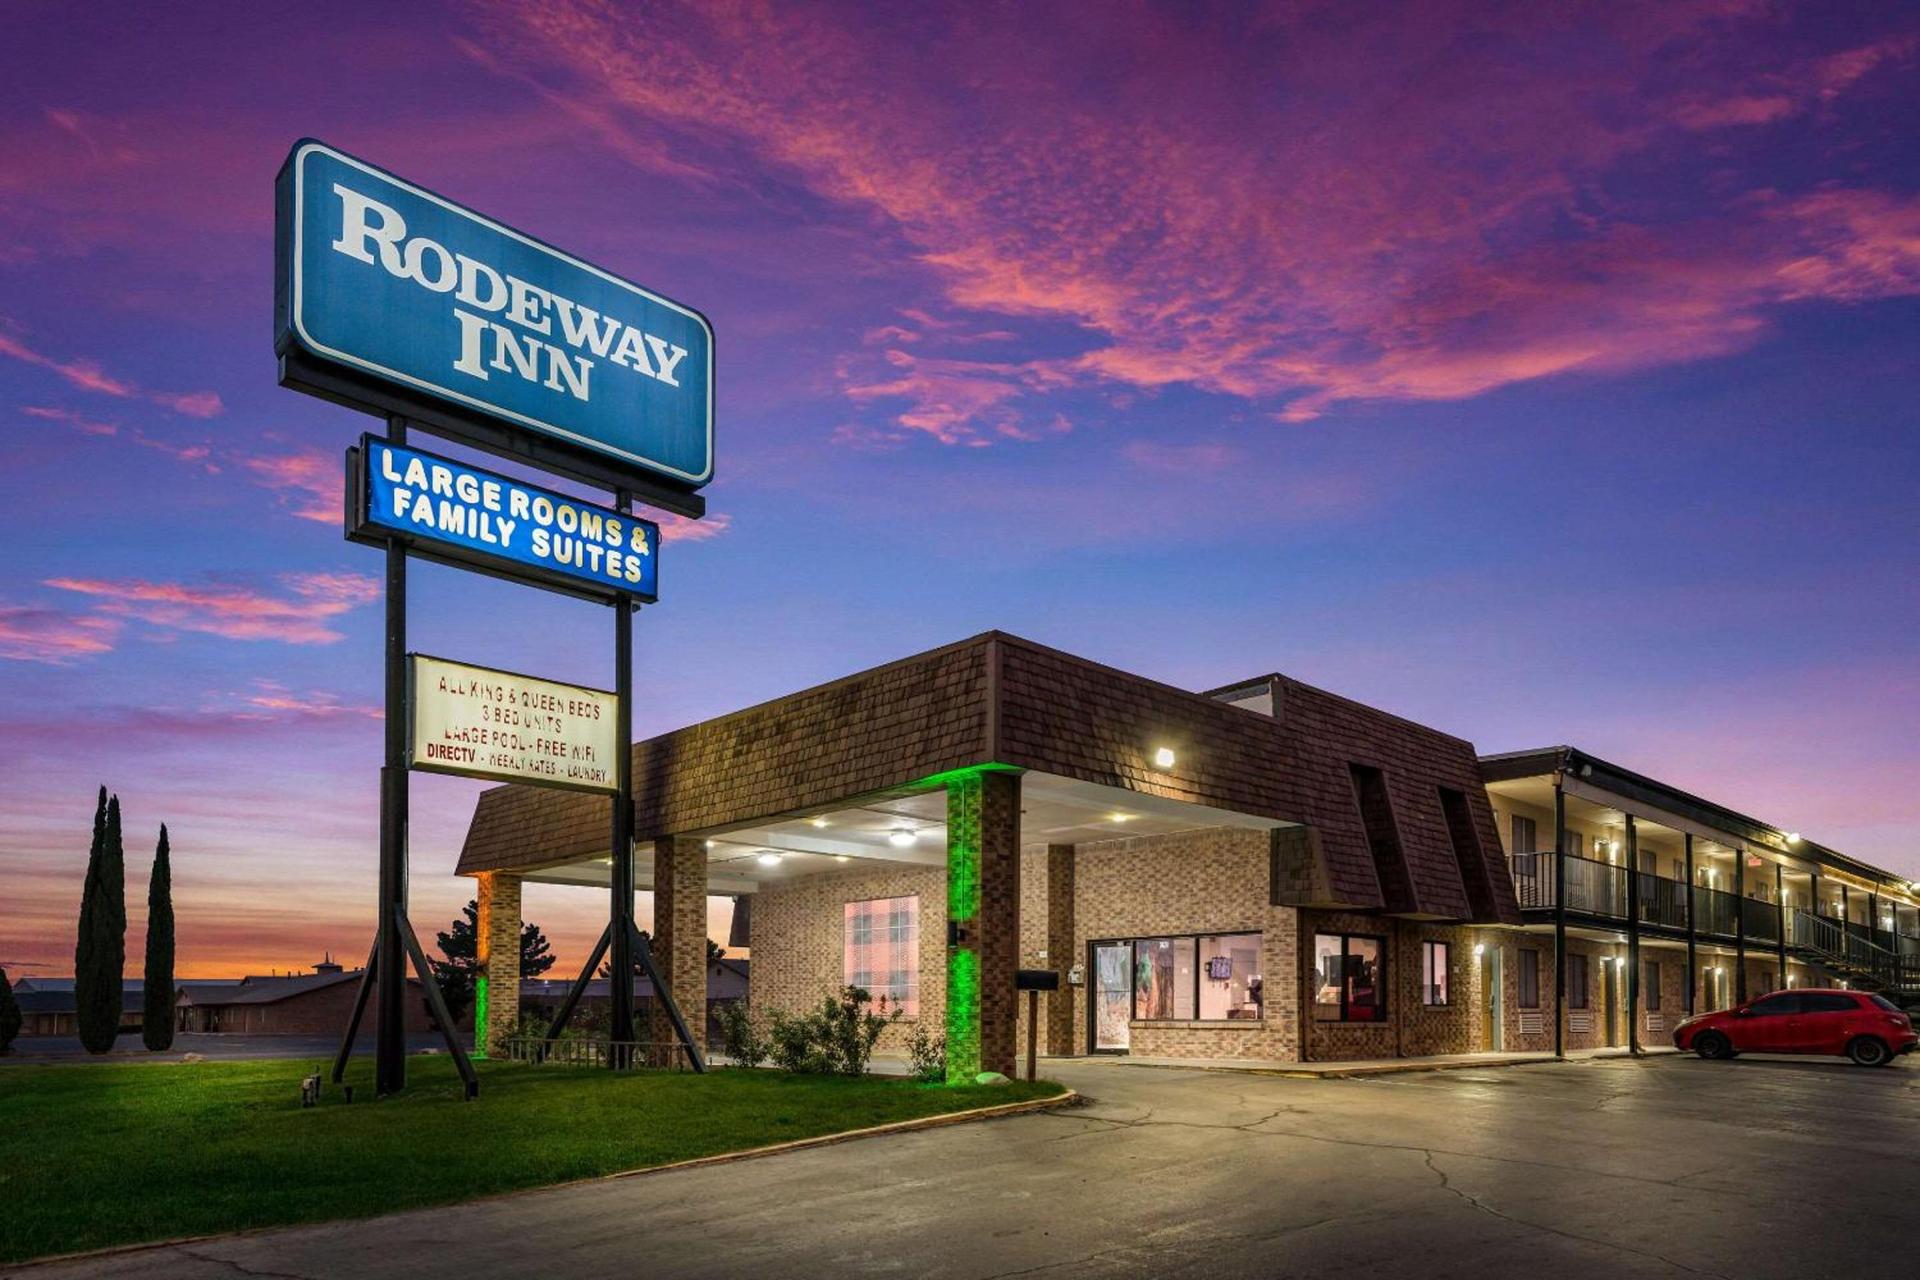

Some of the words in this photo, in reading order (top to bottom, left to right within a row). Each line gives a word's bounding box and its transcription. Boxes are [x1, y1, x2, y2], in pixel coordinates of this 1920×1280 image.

[332, 183, 687, 387] RODEWAY
[453, 307, 594, 401] INN
[382, 448, 501, 512] LARGE
[510, 488, 622, 547] ROOMS
[630, 526, 650, 556] &
[393, 487, 516, 548] FAMILY
[531, 528, 642, 583] SUITES
[439, 676, 465, 695] ALL
[470, 680, 503, 702] KING
[509, 688, 516, 704] &
[521, 691, 564, 713] QUEEN
[482, 705, 490, 721] 3
[494, 707, 519, 725] BED
[524, 712, 562, 733] UNITS
[427, 743, 476, 763] DIRECTV
[489, 752, 525, 770] WEEKLY
[529, 759, 555, 775] RATES
[567, 764, 606, 782] LAUNDRY
[445, 725, 487, 744] LARGE
[492, 731, 526, 751] POOL
[536, 738, 567, 757] FREE
